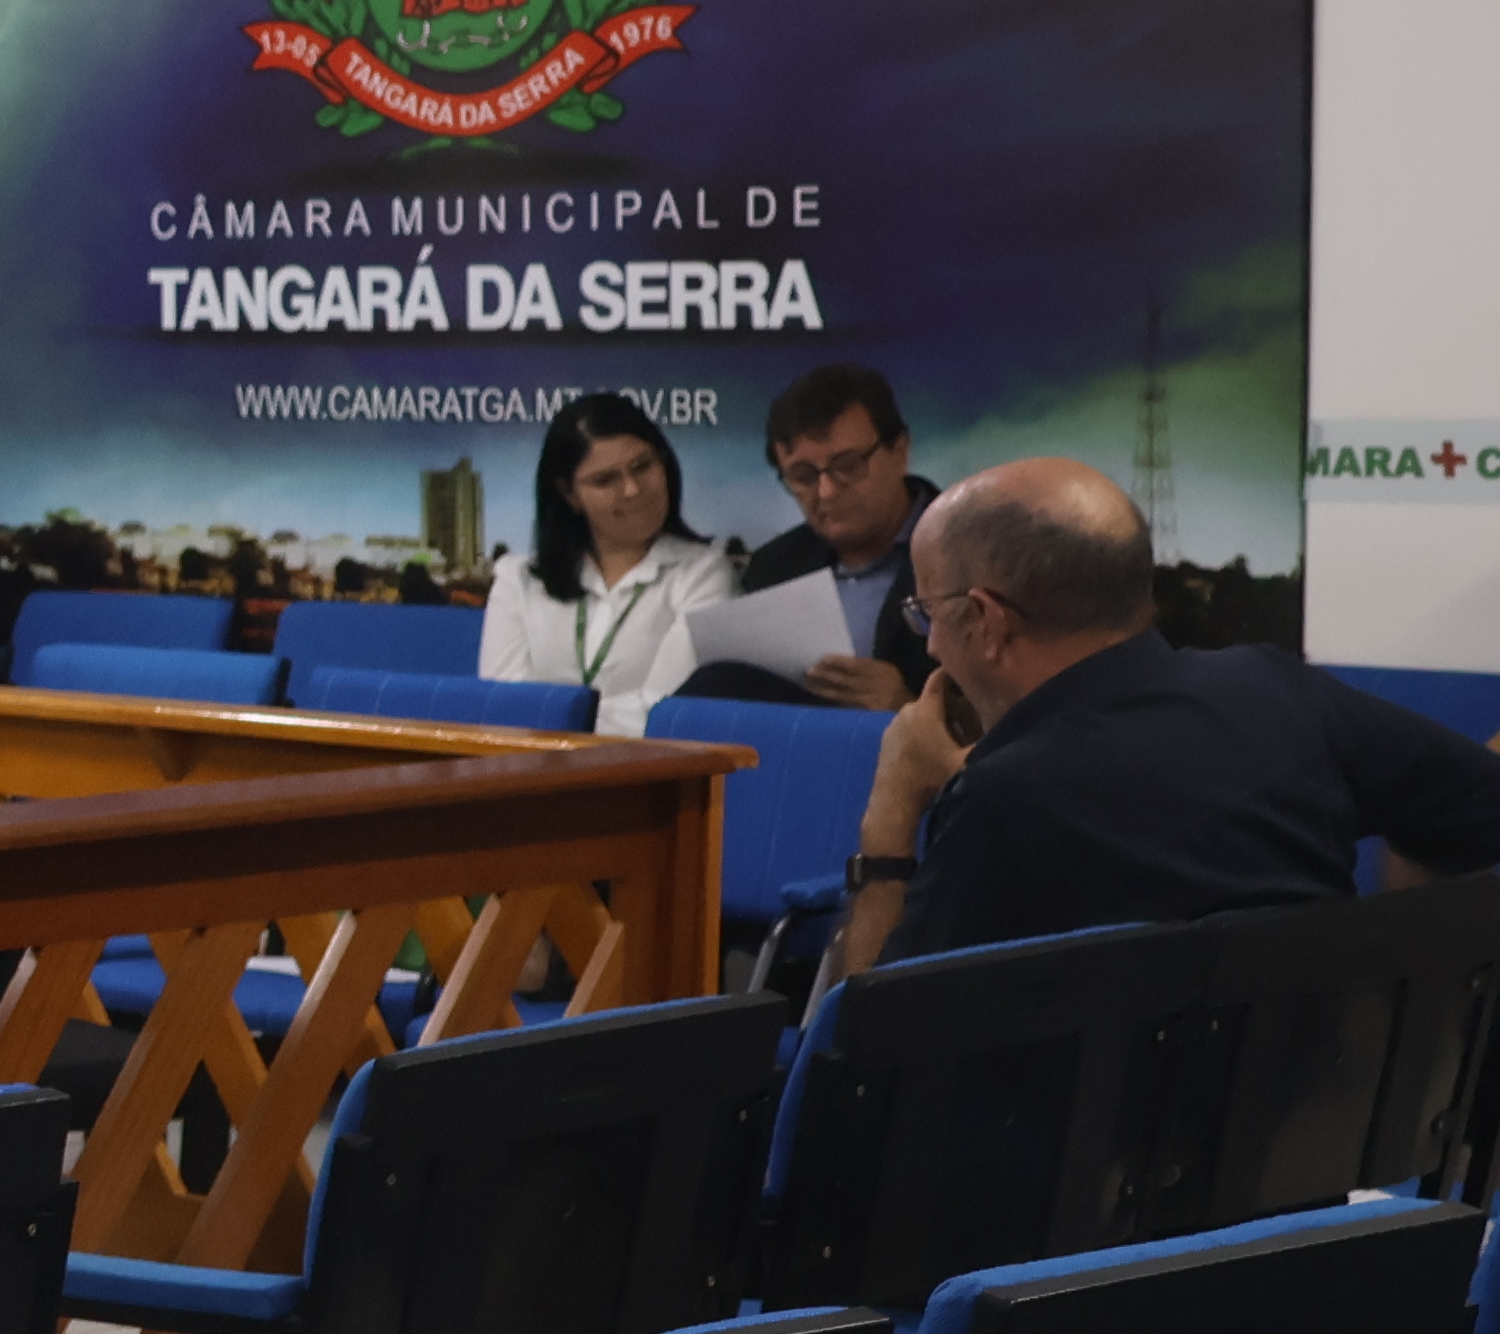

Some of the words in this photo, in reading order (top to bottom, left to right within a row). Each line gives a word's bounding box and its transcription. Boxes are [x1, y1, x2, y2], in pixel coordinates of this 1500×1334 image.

[345, 49, 455, 128] TANGARÁ
[459, 102, 497, 129] DA
[500, 47, 586, 119] SERRA
[609, 14, 673, 55] 1976
[150, 193, 372, 241] CÂMARA
[392, 190, 720, 237] MUNICIPAL
[746, 185, 822, 230] DE
[148, 243, 449, 333] TANGARÁ
[466, 264, 563, 332] DA
[578, 259, 824, 333] SERRA
